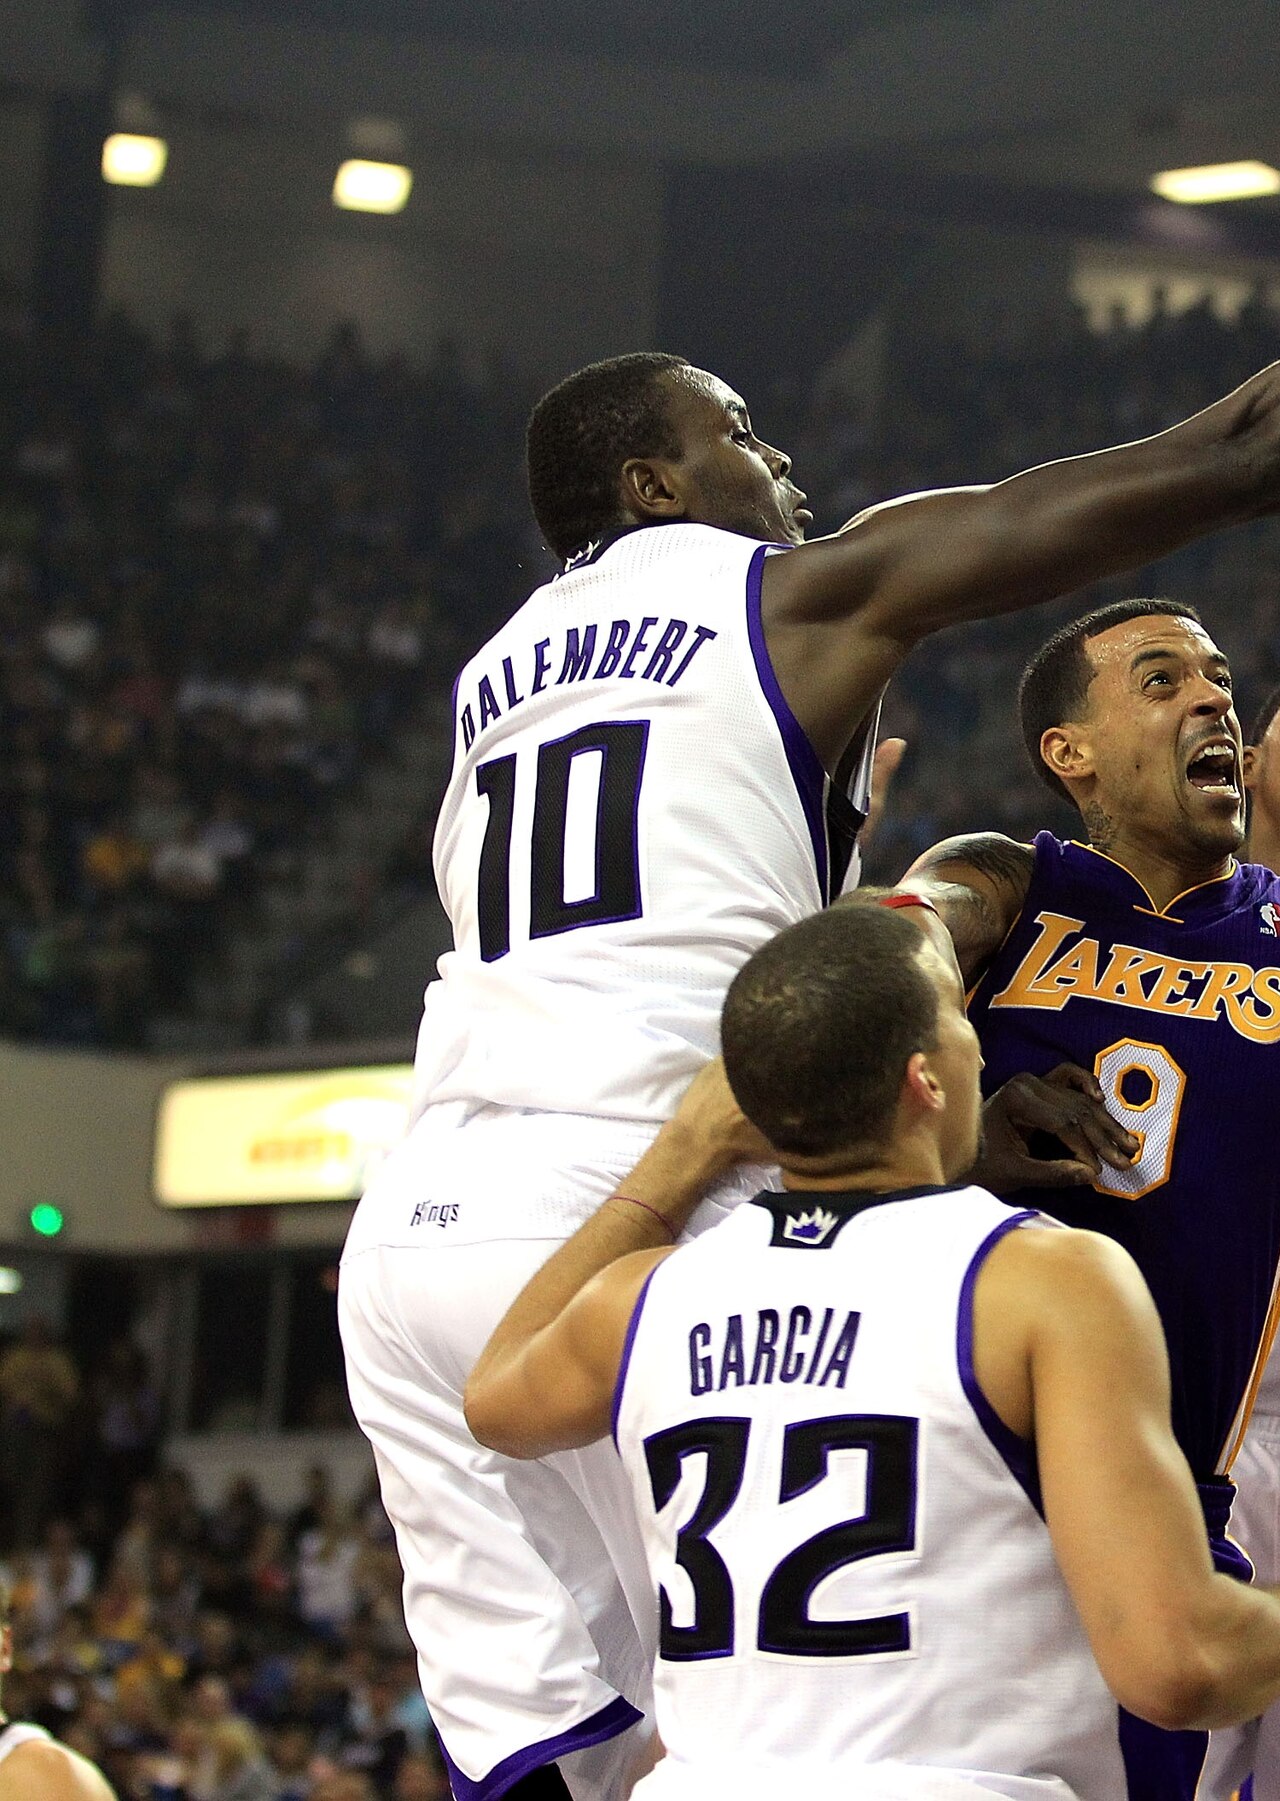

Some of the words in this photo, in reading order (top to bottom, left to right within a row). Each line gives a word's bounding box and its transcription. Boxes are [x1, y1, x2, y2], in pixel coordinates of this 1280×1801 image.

[460, 617, 718, 754] DALEMBERT
[475, 719, 650, 964] 10
[1259, 926, 1275, 935] NBA
[1093, 1037, 1187, 1200] 9
[410, 1199, 460, 1228] Kings
[689, 1305, 862, 1396] GARCIA
[643, 1413, 920, 1662] 32
